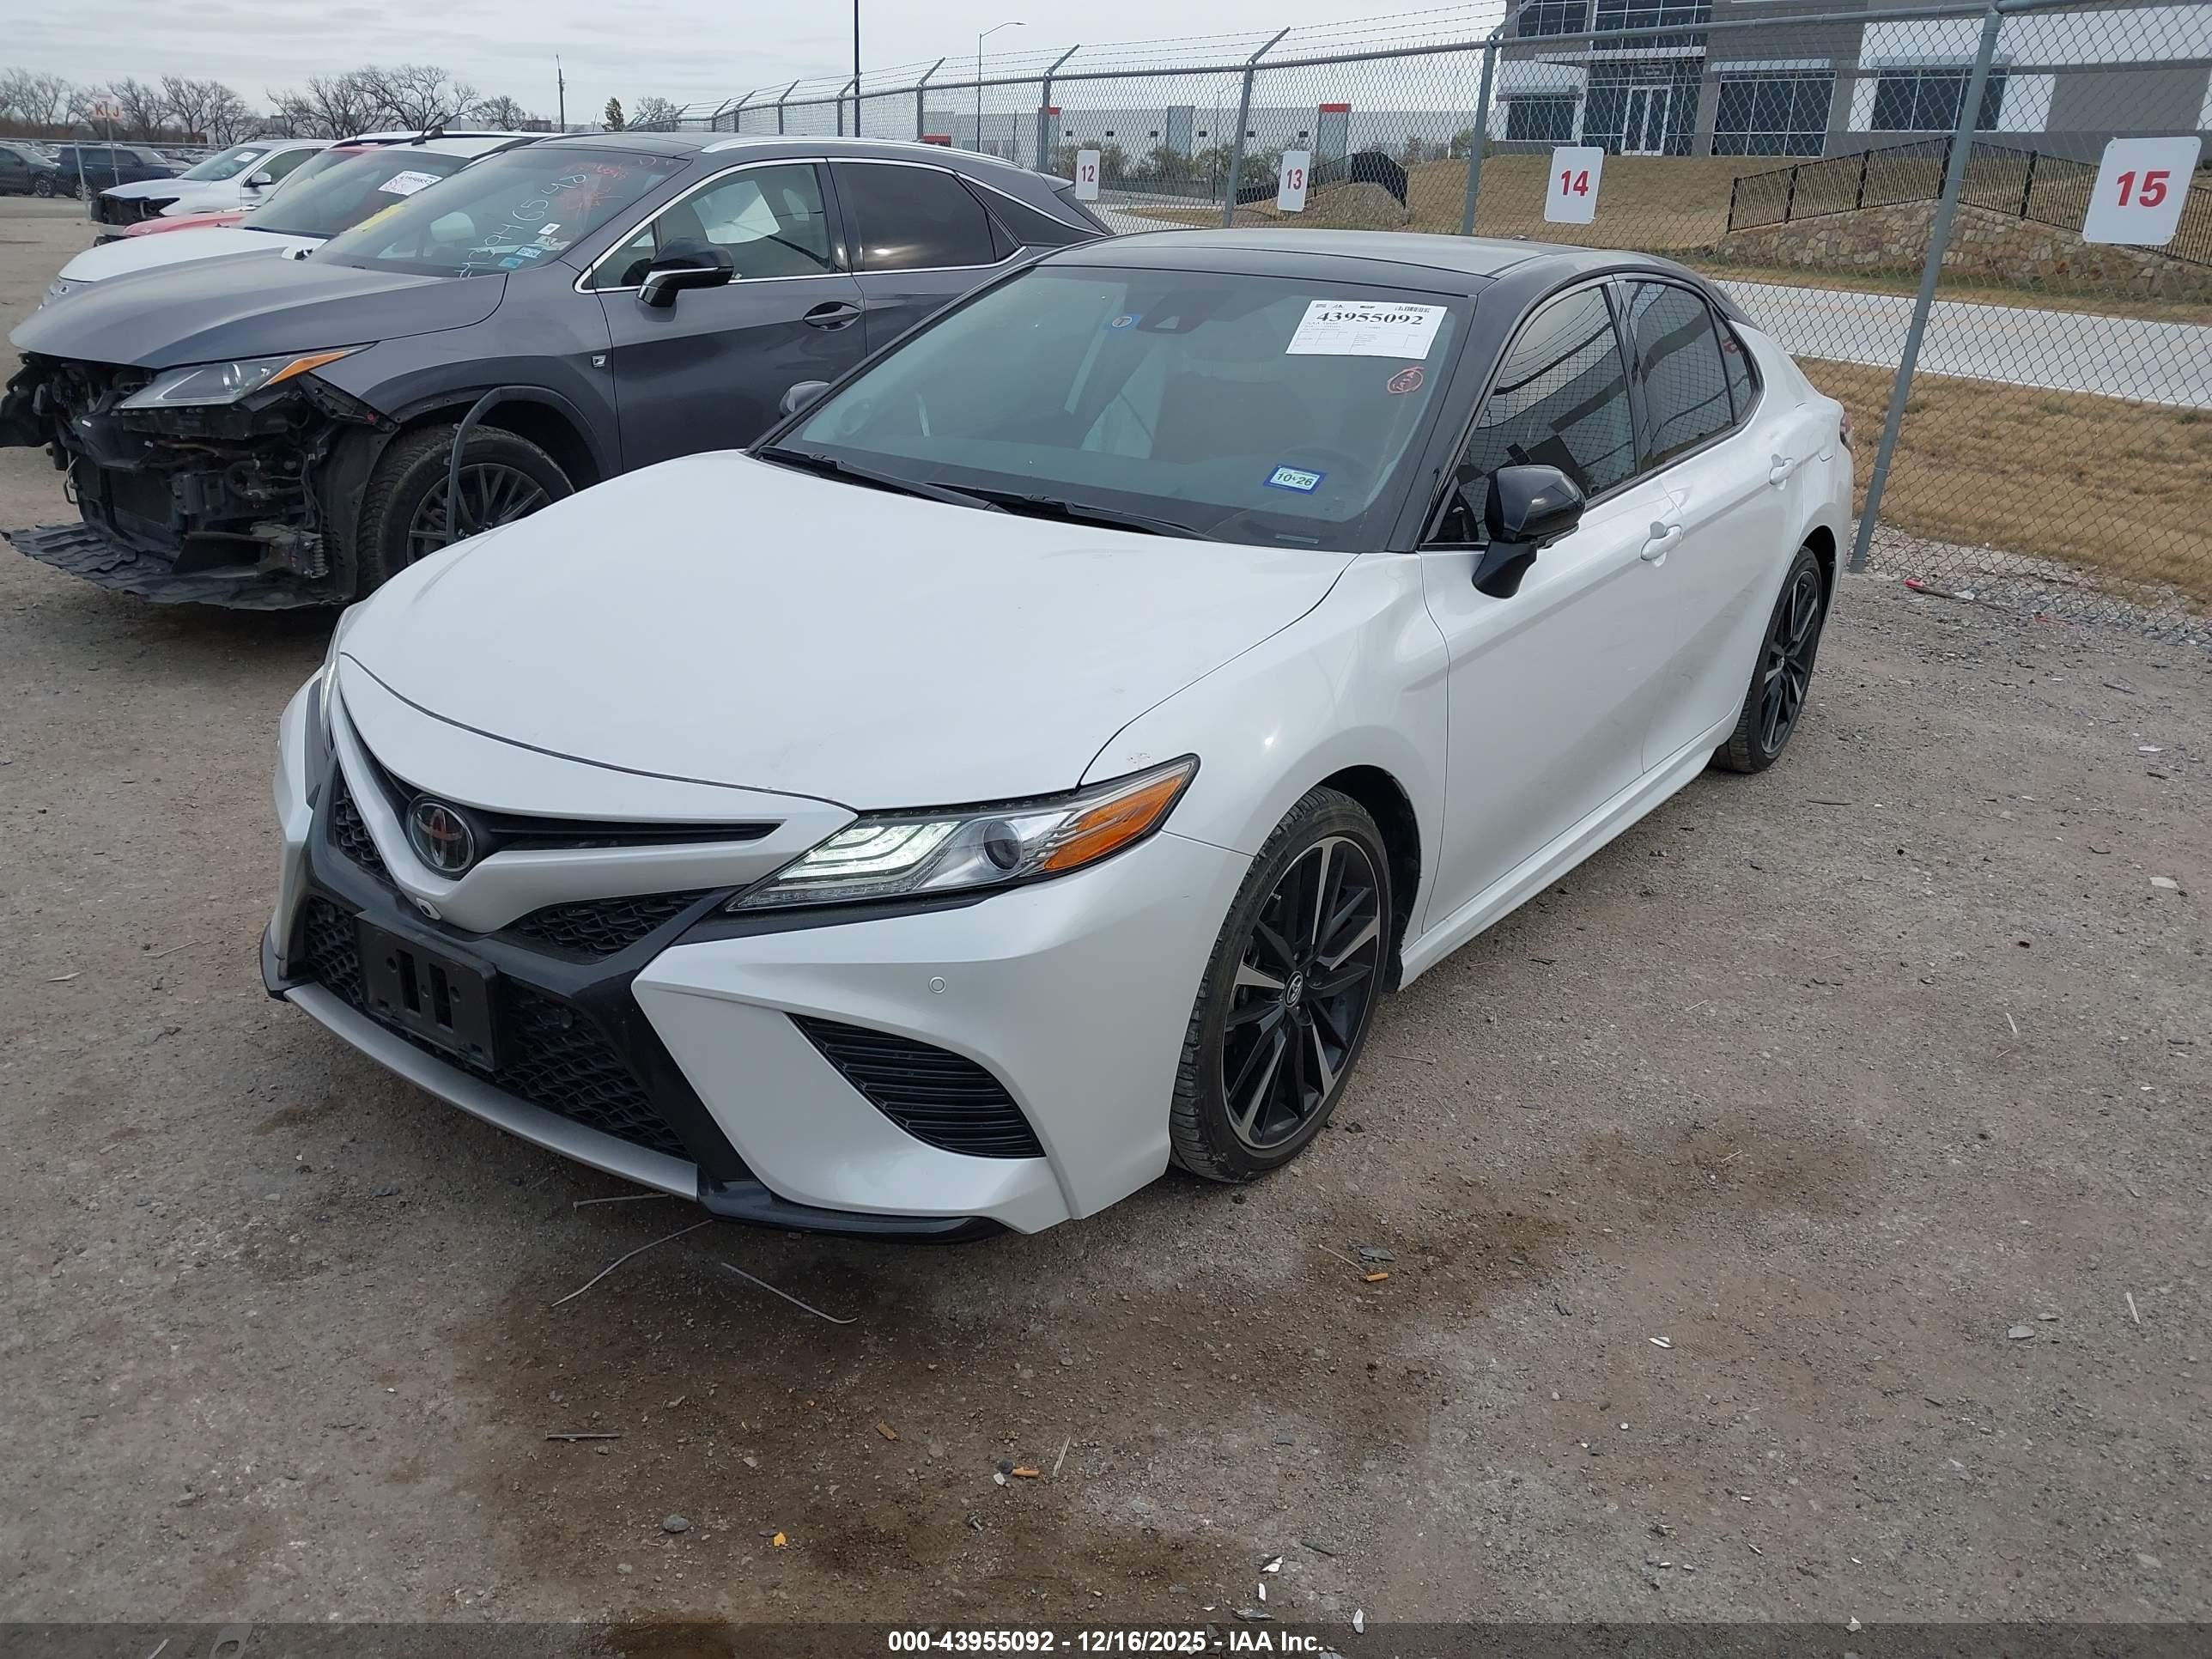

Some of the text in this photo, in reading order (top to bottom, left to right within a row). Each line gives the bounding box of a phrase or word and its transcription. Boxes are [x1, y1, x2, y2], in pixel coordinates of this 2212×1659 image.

[94, 103, 105, 117] K
[1081, 165, 1095, 183] 12
[1286, 168, 1304, 191] 13
[1560, 170, 1589, 197] 14
[2116, 171, 2172, 208] 15
[1316, 311, 1424, 325] 43955092
